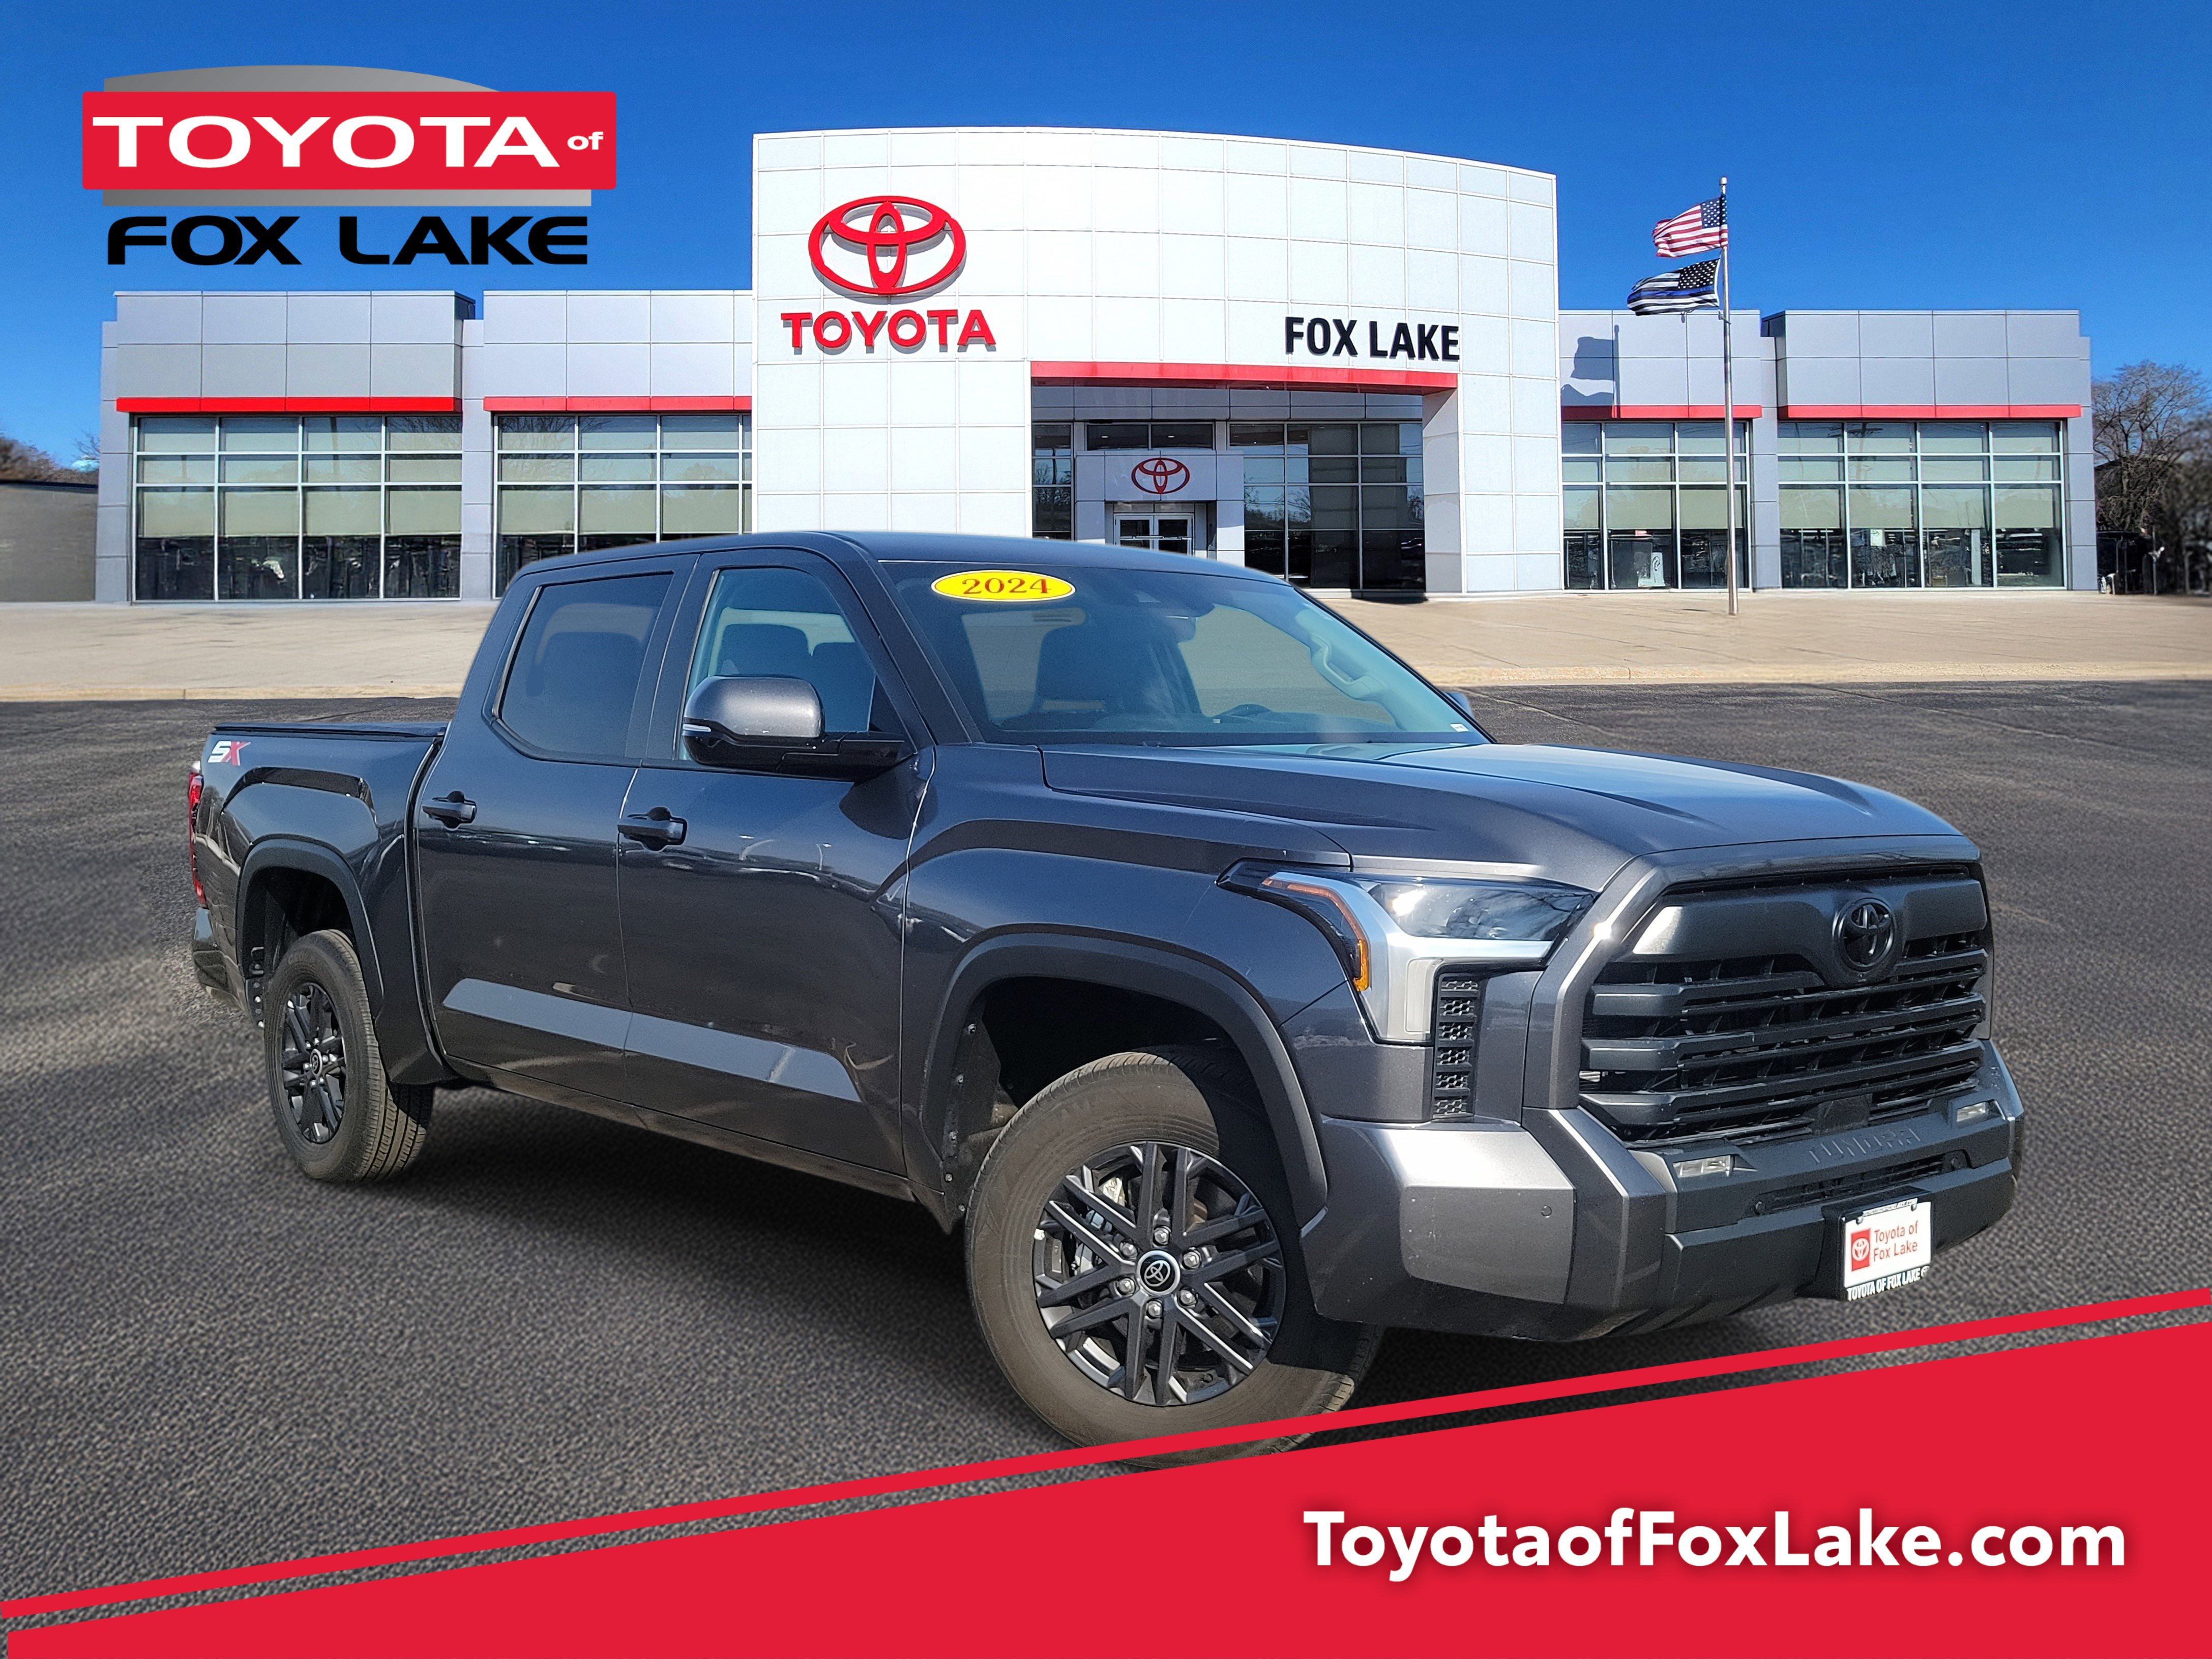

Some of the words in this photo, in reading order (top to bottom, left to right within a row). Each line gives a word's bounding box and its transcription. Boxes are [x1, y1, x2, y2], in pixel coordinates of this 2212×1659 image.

[781, 309, 996, 350] TOYOTA
[1285, 316, 1358, 355] FOX
[1369, 321, 1460, 361] LAKE
[962, 578, 1051, 595] 2024
[1874, 1225, 1905, 1244] Toyota
[1908, 1220, 1919, 1234] of
[1873, 1247, 1890, 1262] Fox
[1894, 1240, 1918, 1256] Lake
[1846, 1281, 1875, 1301] TOYOTA
[1876, 1278, 1886, 1292] OF
[1886, 1272, 1902, 1290] FOX
[1902, 1267, 1921, 1284] LAKE
